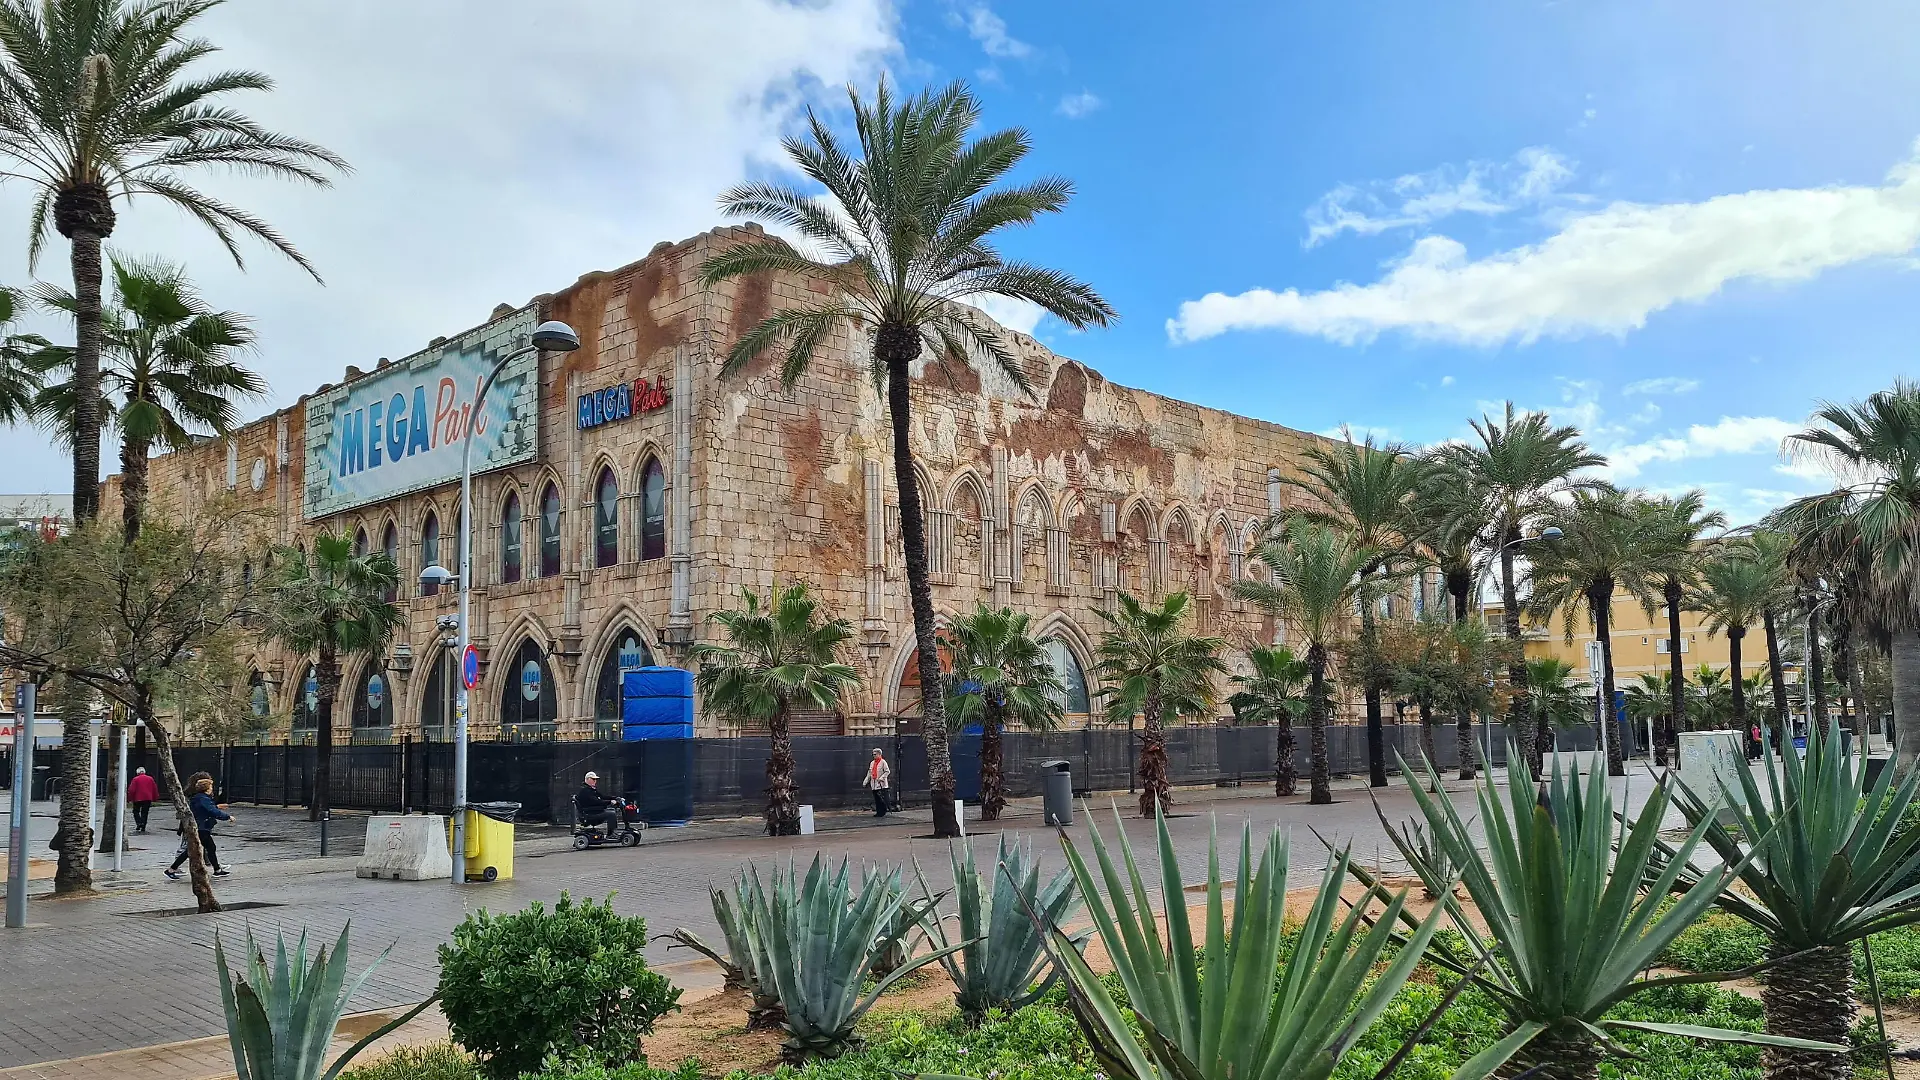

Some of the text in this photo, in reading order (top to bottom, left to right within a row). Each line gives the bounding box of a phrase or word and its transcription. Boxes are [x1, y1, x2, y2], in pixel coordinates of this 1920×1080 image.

[339, 375, 488, 478] MEGA Park
[577, 375, 668, 430] MEGA Park
[620, 653, 641, 667] MEGA
